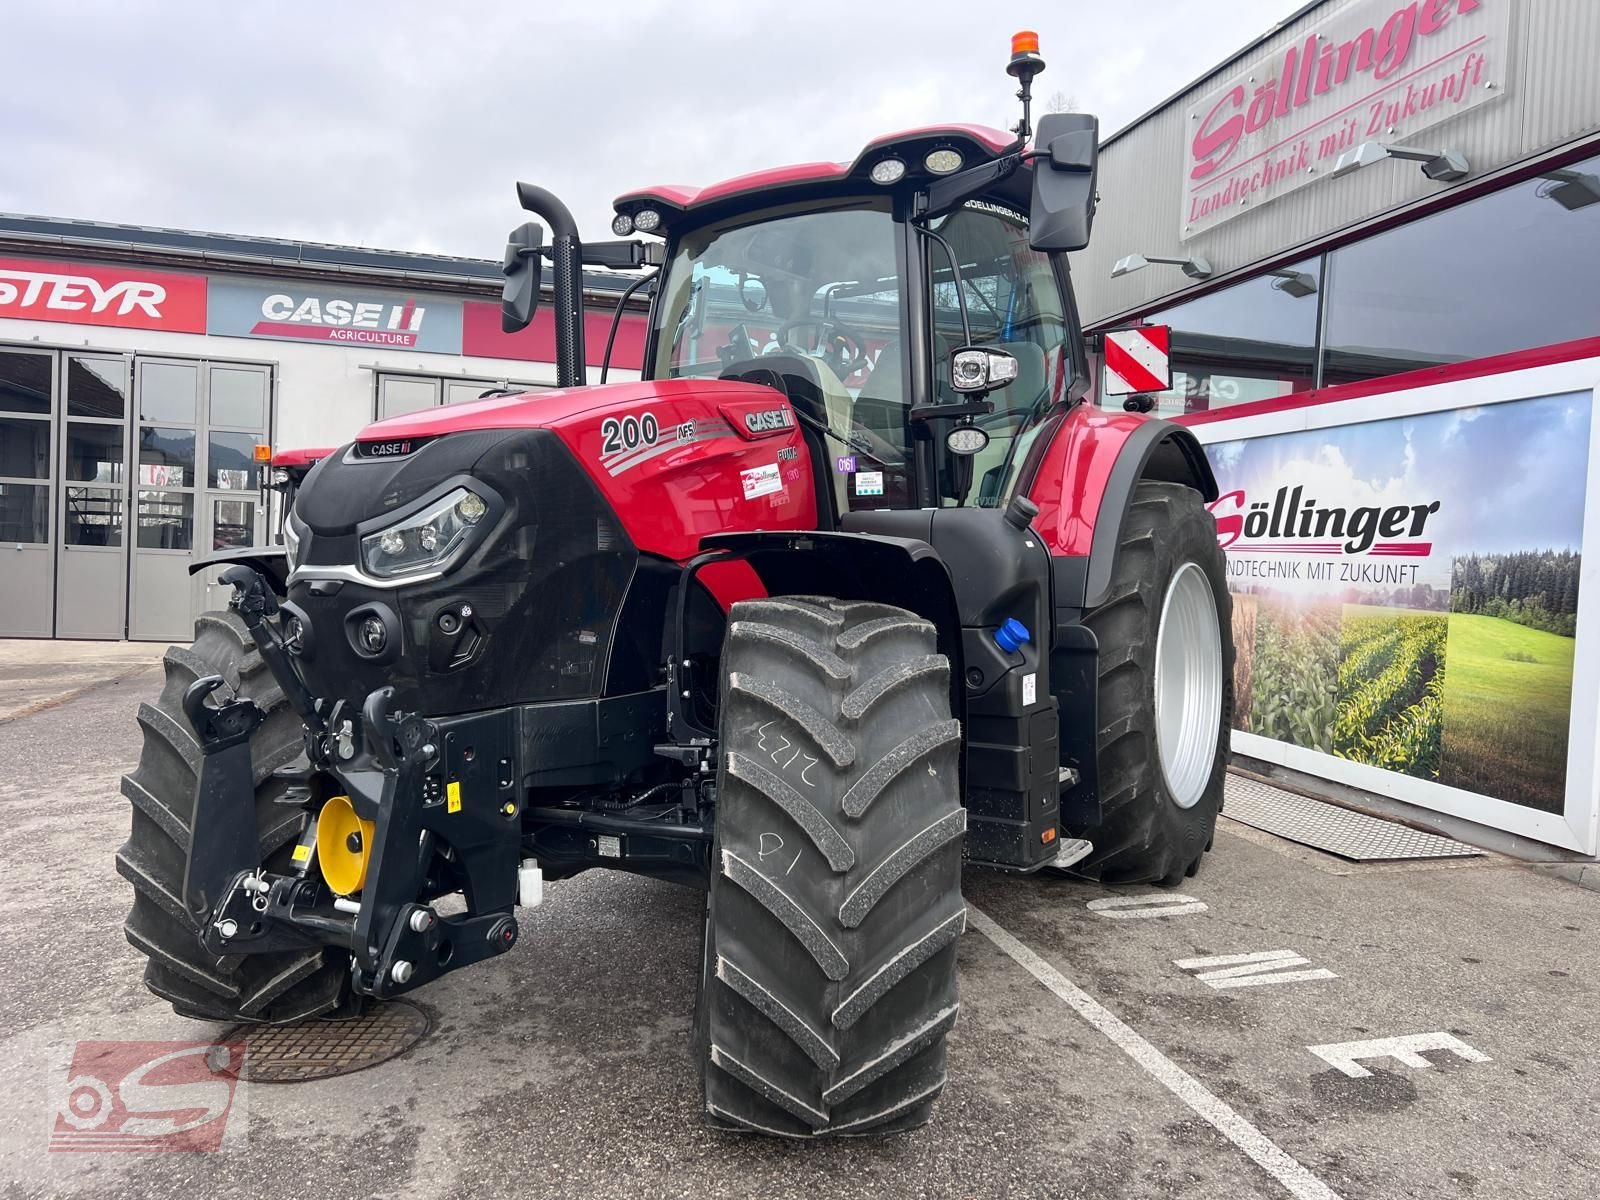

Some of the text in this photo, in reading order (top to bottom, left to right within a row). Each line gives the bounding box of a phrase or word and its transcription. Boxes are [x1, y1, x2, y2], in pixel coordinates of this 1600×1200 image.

[1189, 53, 1486, 223] Landtechnik mit Zukunft
[261, 294, 384, 328] CASE
[329, 329, 410, 345] AGRICULTURE
[677, 423, 694, 440] AFS
[745, 409, 782, 432] CASE
[601, 411, 659, 457] 200
[371, 442, 401, 455] CASE
[838, 457, 854, 472] 0161
[1206, 485, 1441, 554] Söllinger
[1226, 559, 1420, 585] NDTECHNIK MIT ZUKUNFT
